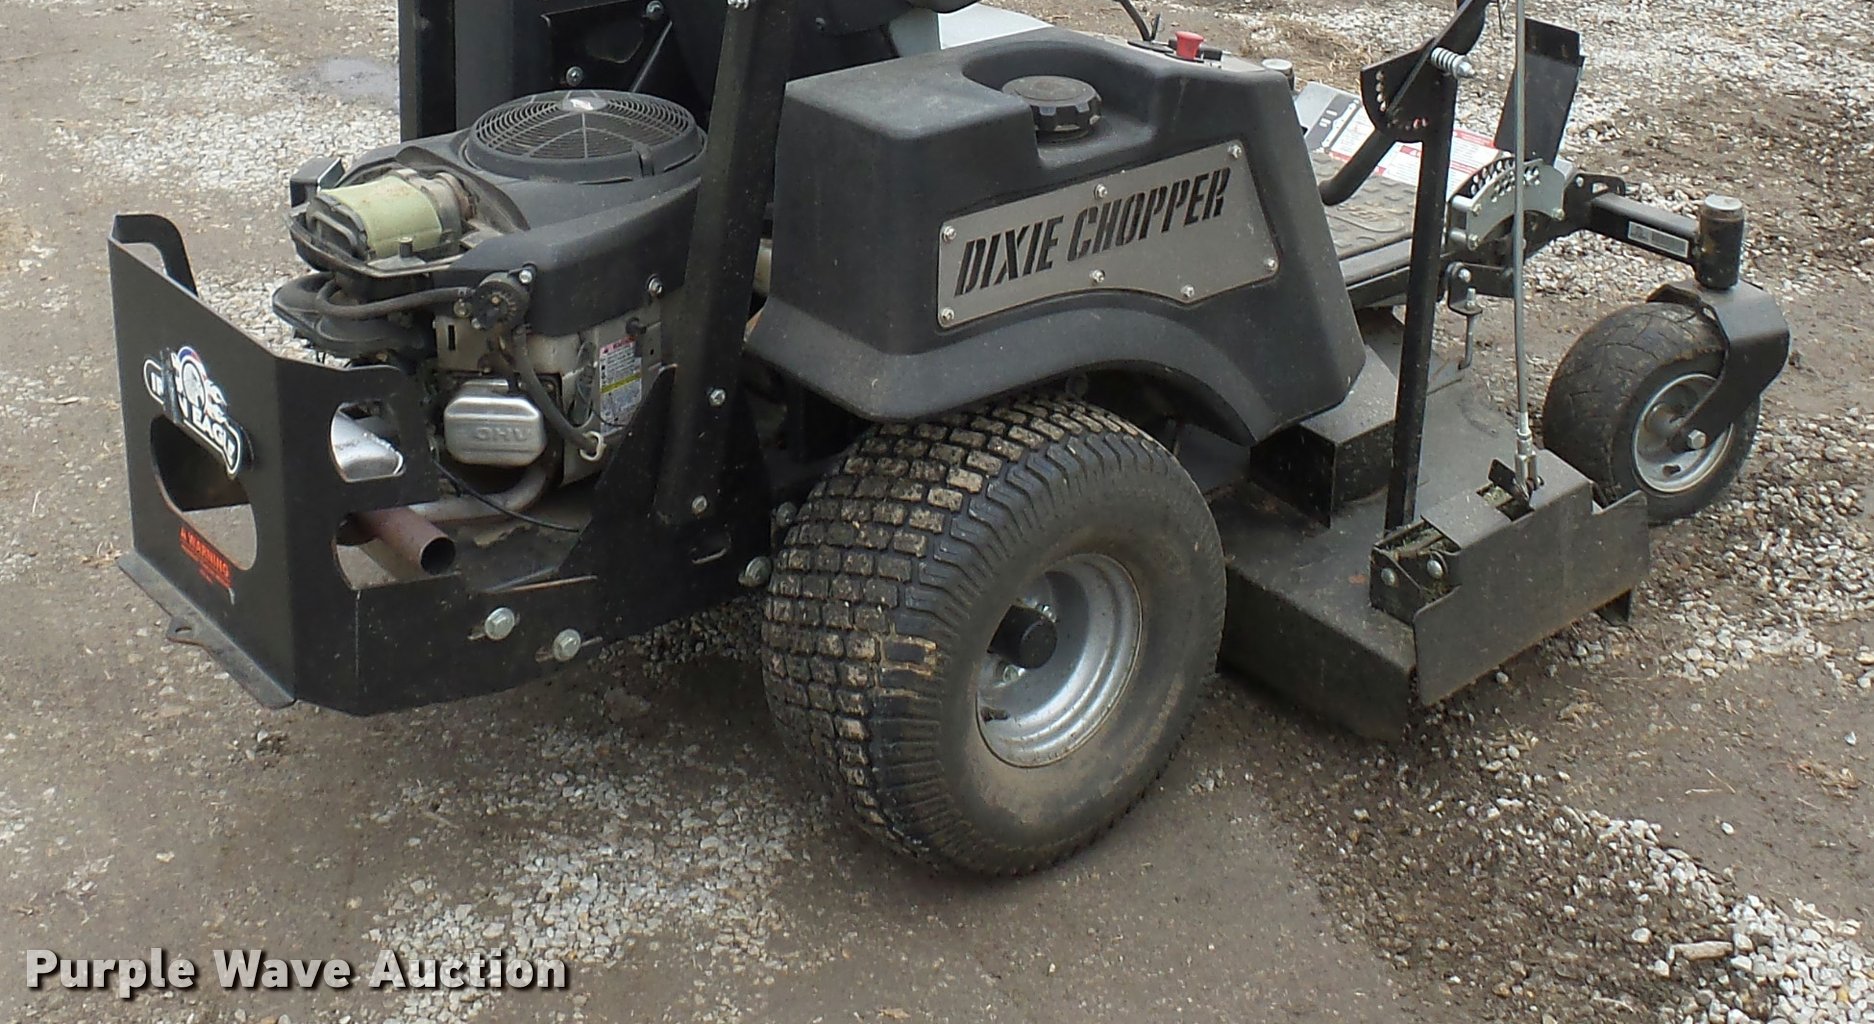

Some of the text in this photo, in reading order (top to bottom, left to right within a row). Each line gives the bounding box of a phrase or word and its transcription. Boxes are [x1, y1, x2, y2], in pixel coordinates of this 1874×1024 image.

[954, 167, 1231, 298] DIXIE CHOPPER
[475, 426, 531, 443] OHV
